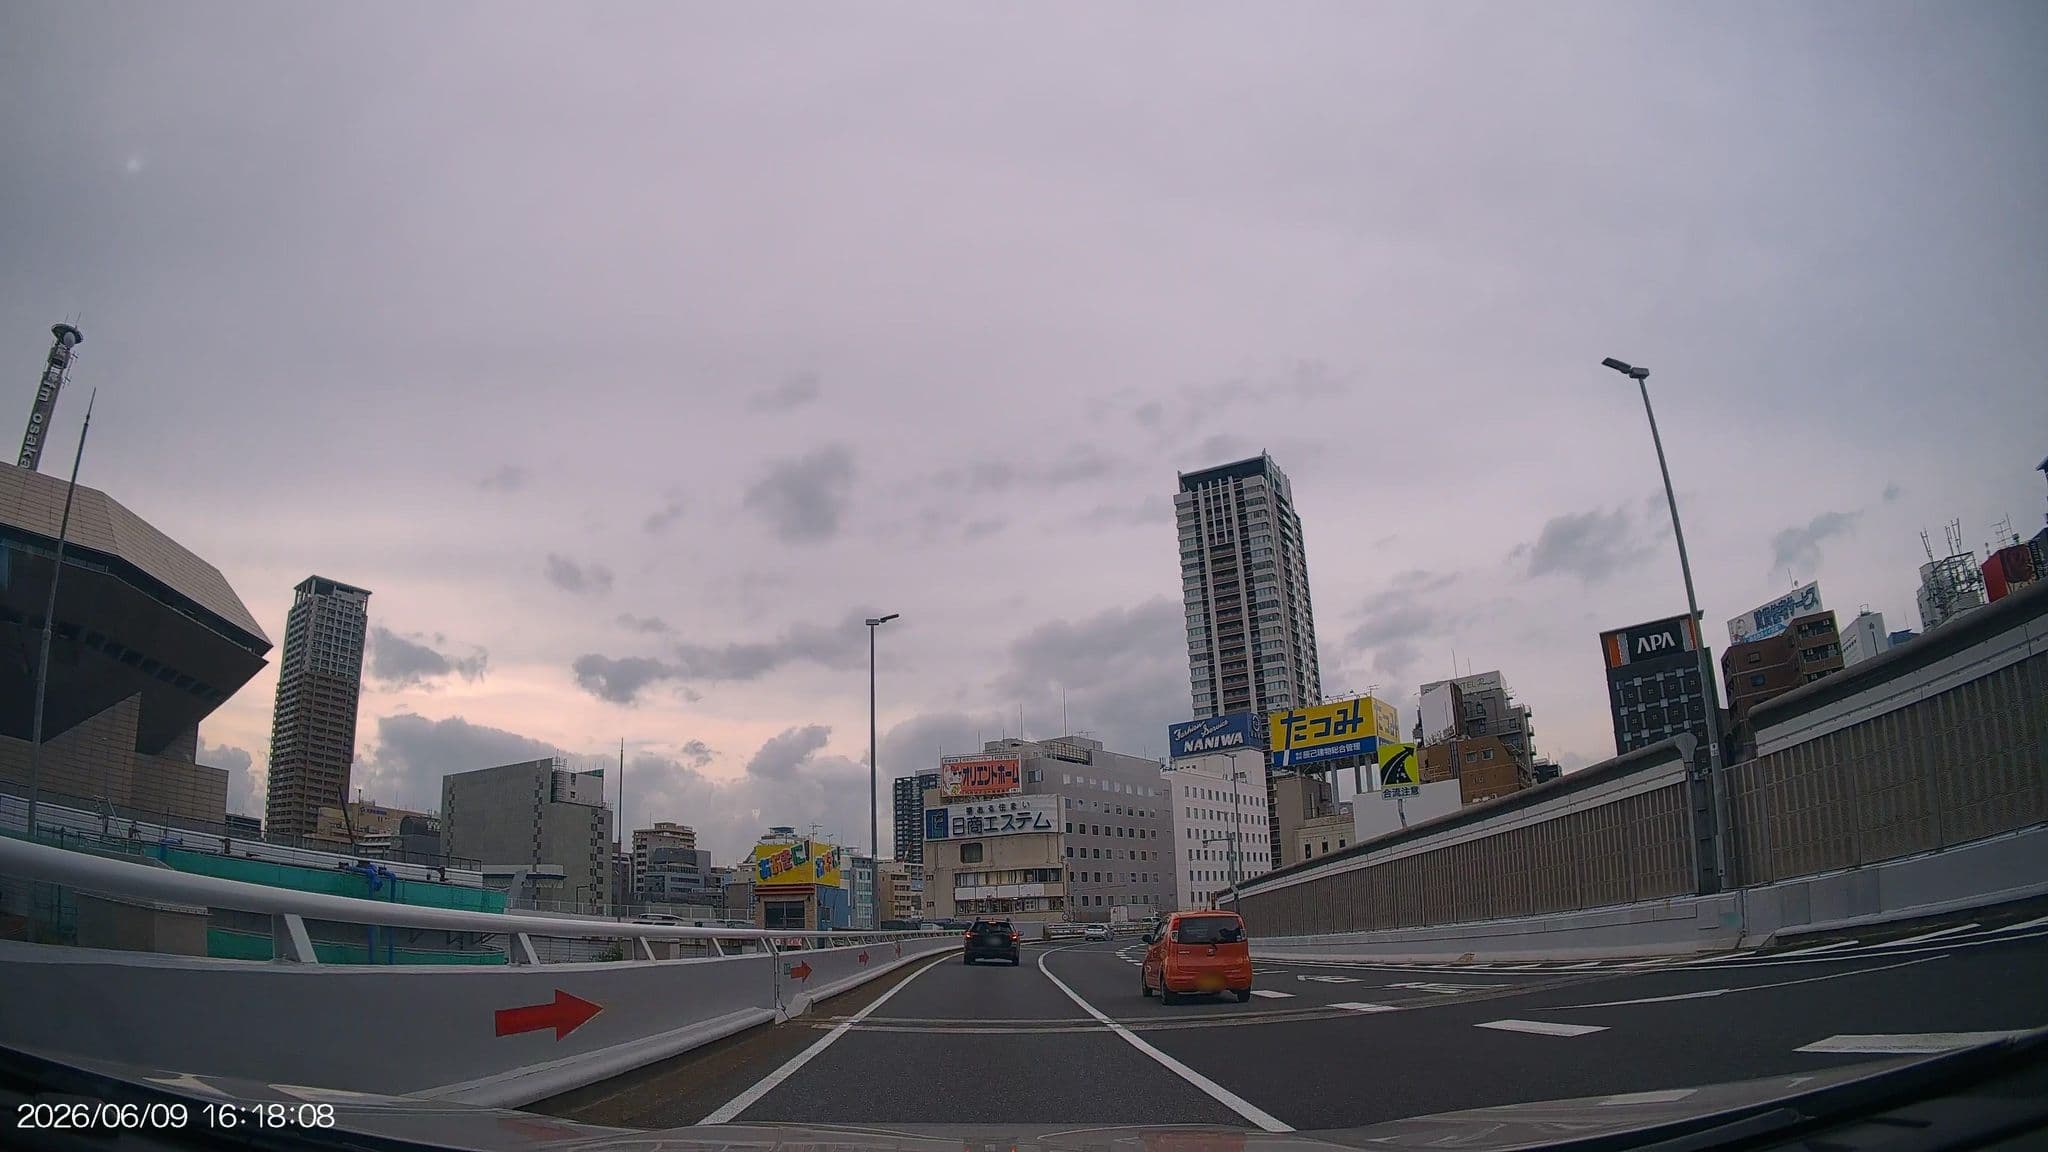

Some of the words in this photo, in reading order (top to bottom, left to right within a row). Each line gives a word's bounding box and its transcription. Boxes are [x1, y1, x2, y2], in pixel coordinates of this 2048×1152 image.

[20, 413, 43, 469] osaka
[1637, 631, 1676, 654] APA
[1174, 720, 1205, 741] Fashion
[1201, 719, 1229, 737] Service
[1280, 699, 1364, 751] たつみ
[1184, 732, 1243, 752] NANIWA
[963, 764, 1020, 786] オリエントホーム
[1383, 786, 1419, 798] 合流注意
[952, 812, 1052, 835] 日商エステム
